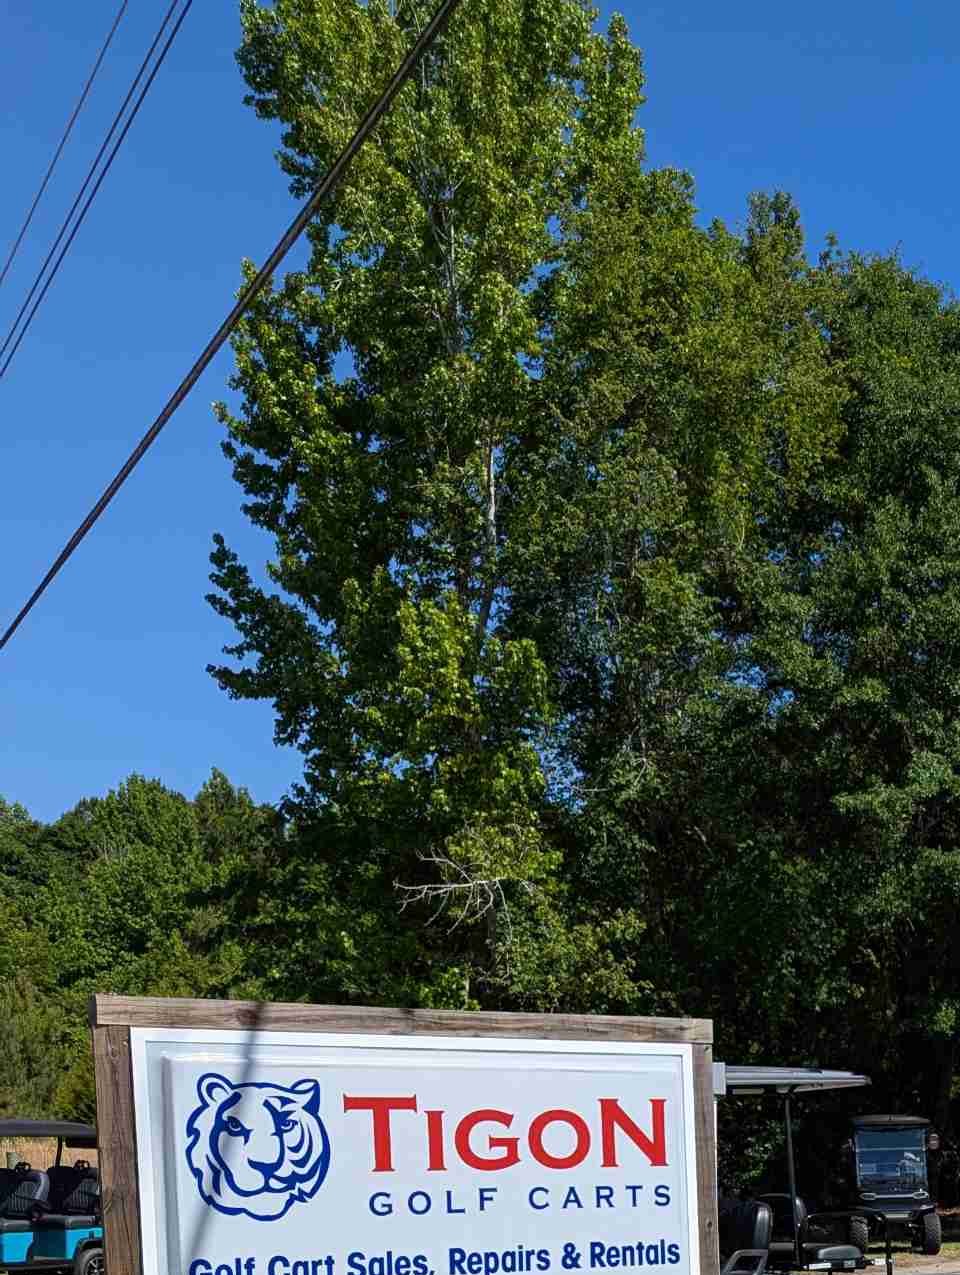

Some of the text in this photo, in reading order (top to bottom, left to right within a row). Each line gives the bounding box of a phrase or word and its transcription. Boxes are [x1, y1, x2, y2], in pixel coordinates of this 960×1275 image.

[368, 1184, 672, 1217] GOLF CARTS
[561, 1242, 581, 1270] &
[589, 1239, 681, 1268] Rentals
